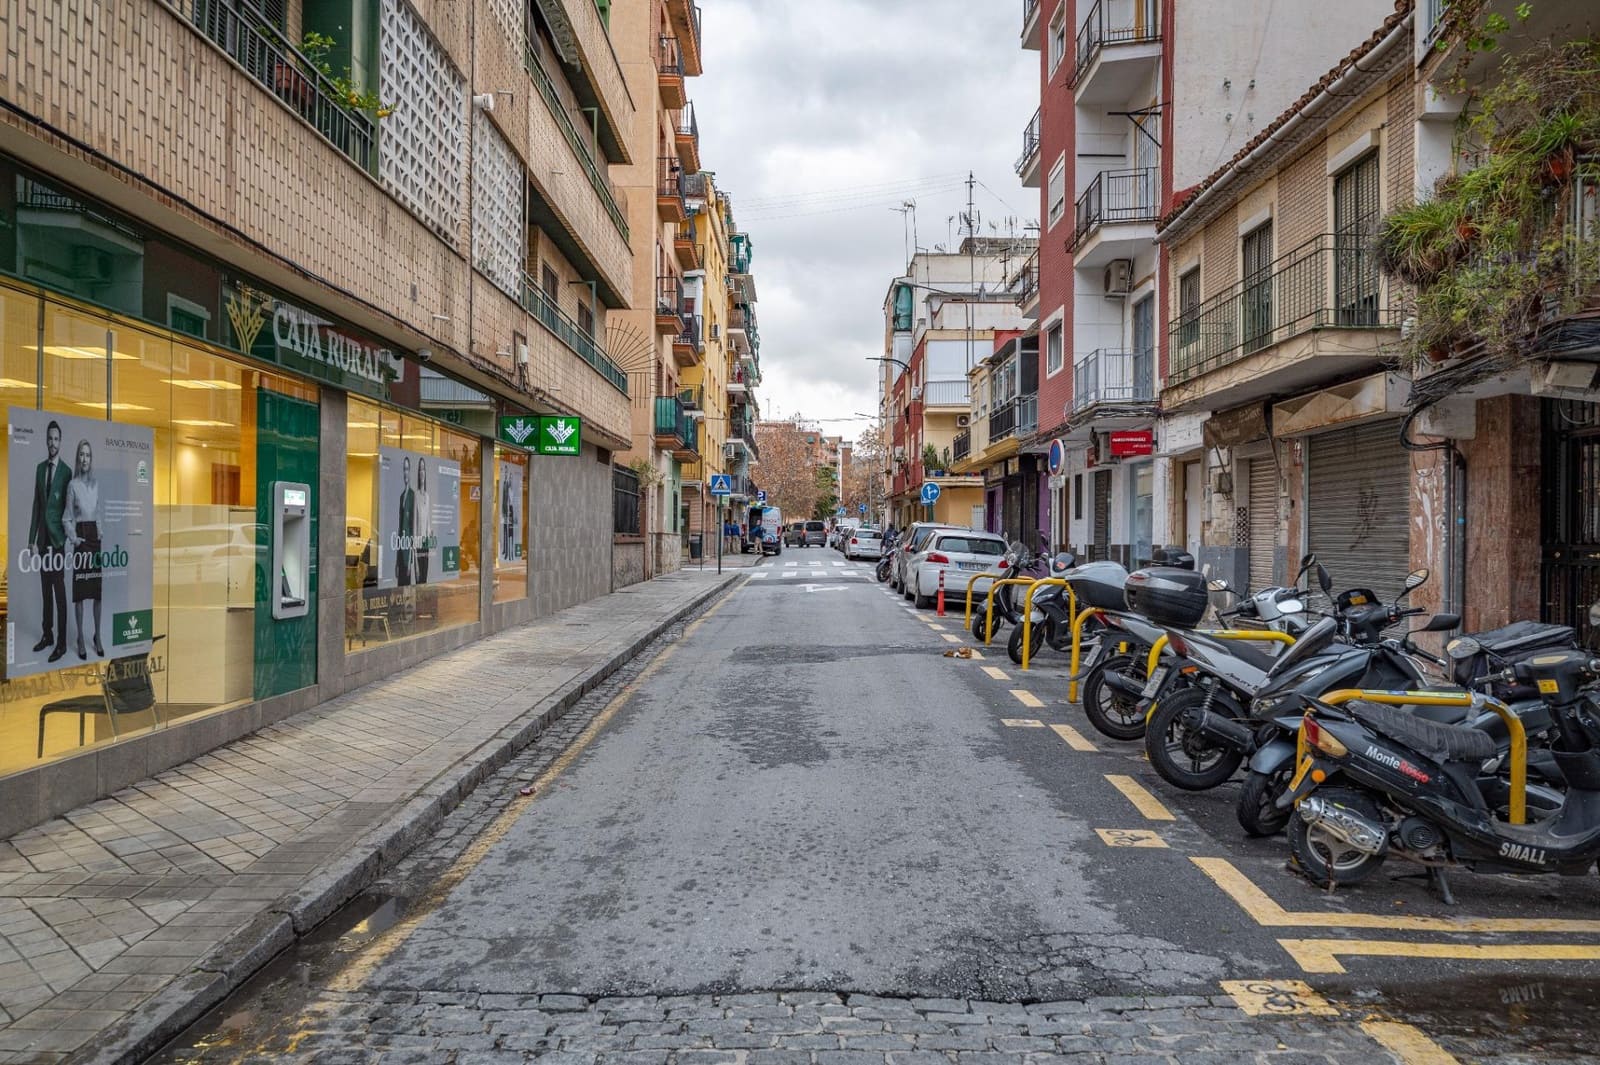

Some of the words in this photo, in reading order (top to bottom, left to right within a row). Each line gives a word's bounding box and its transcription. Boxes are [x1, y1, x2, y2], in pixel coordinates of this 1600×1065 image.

[273, 306, 324, 362] CAJA
[326, 329, 384, 384] RURAL
[1498, 841, 1547, 865] SMALL
